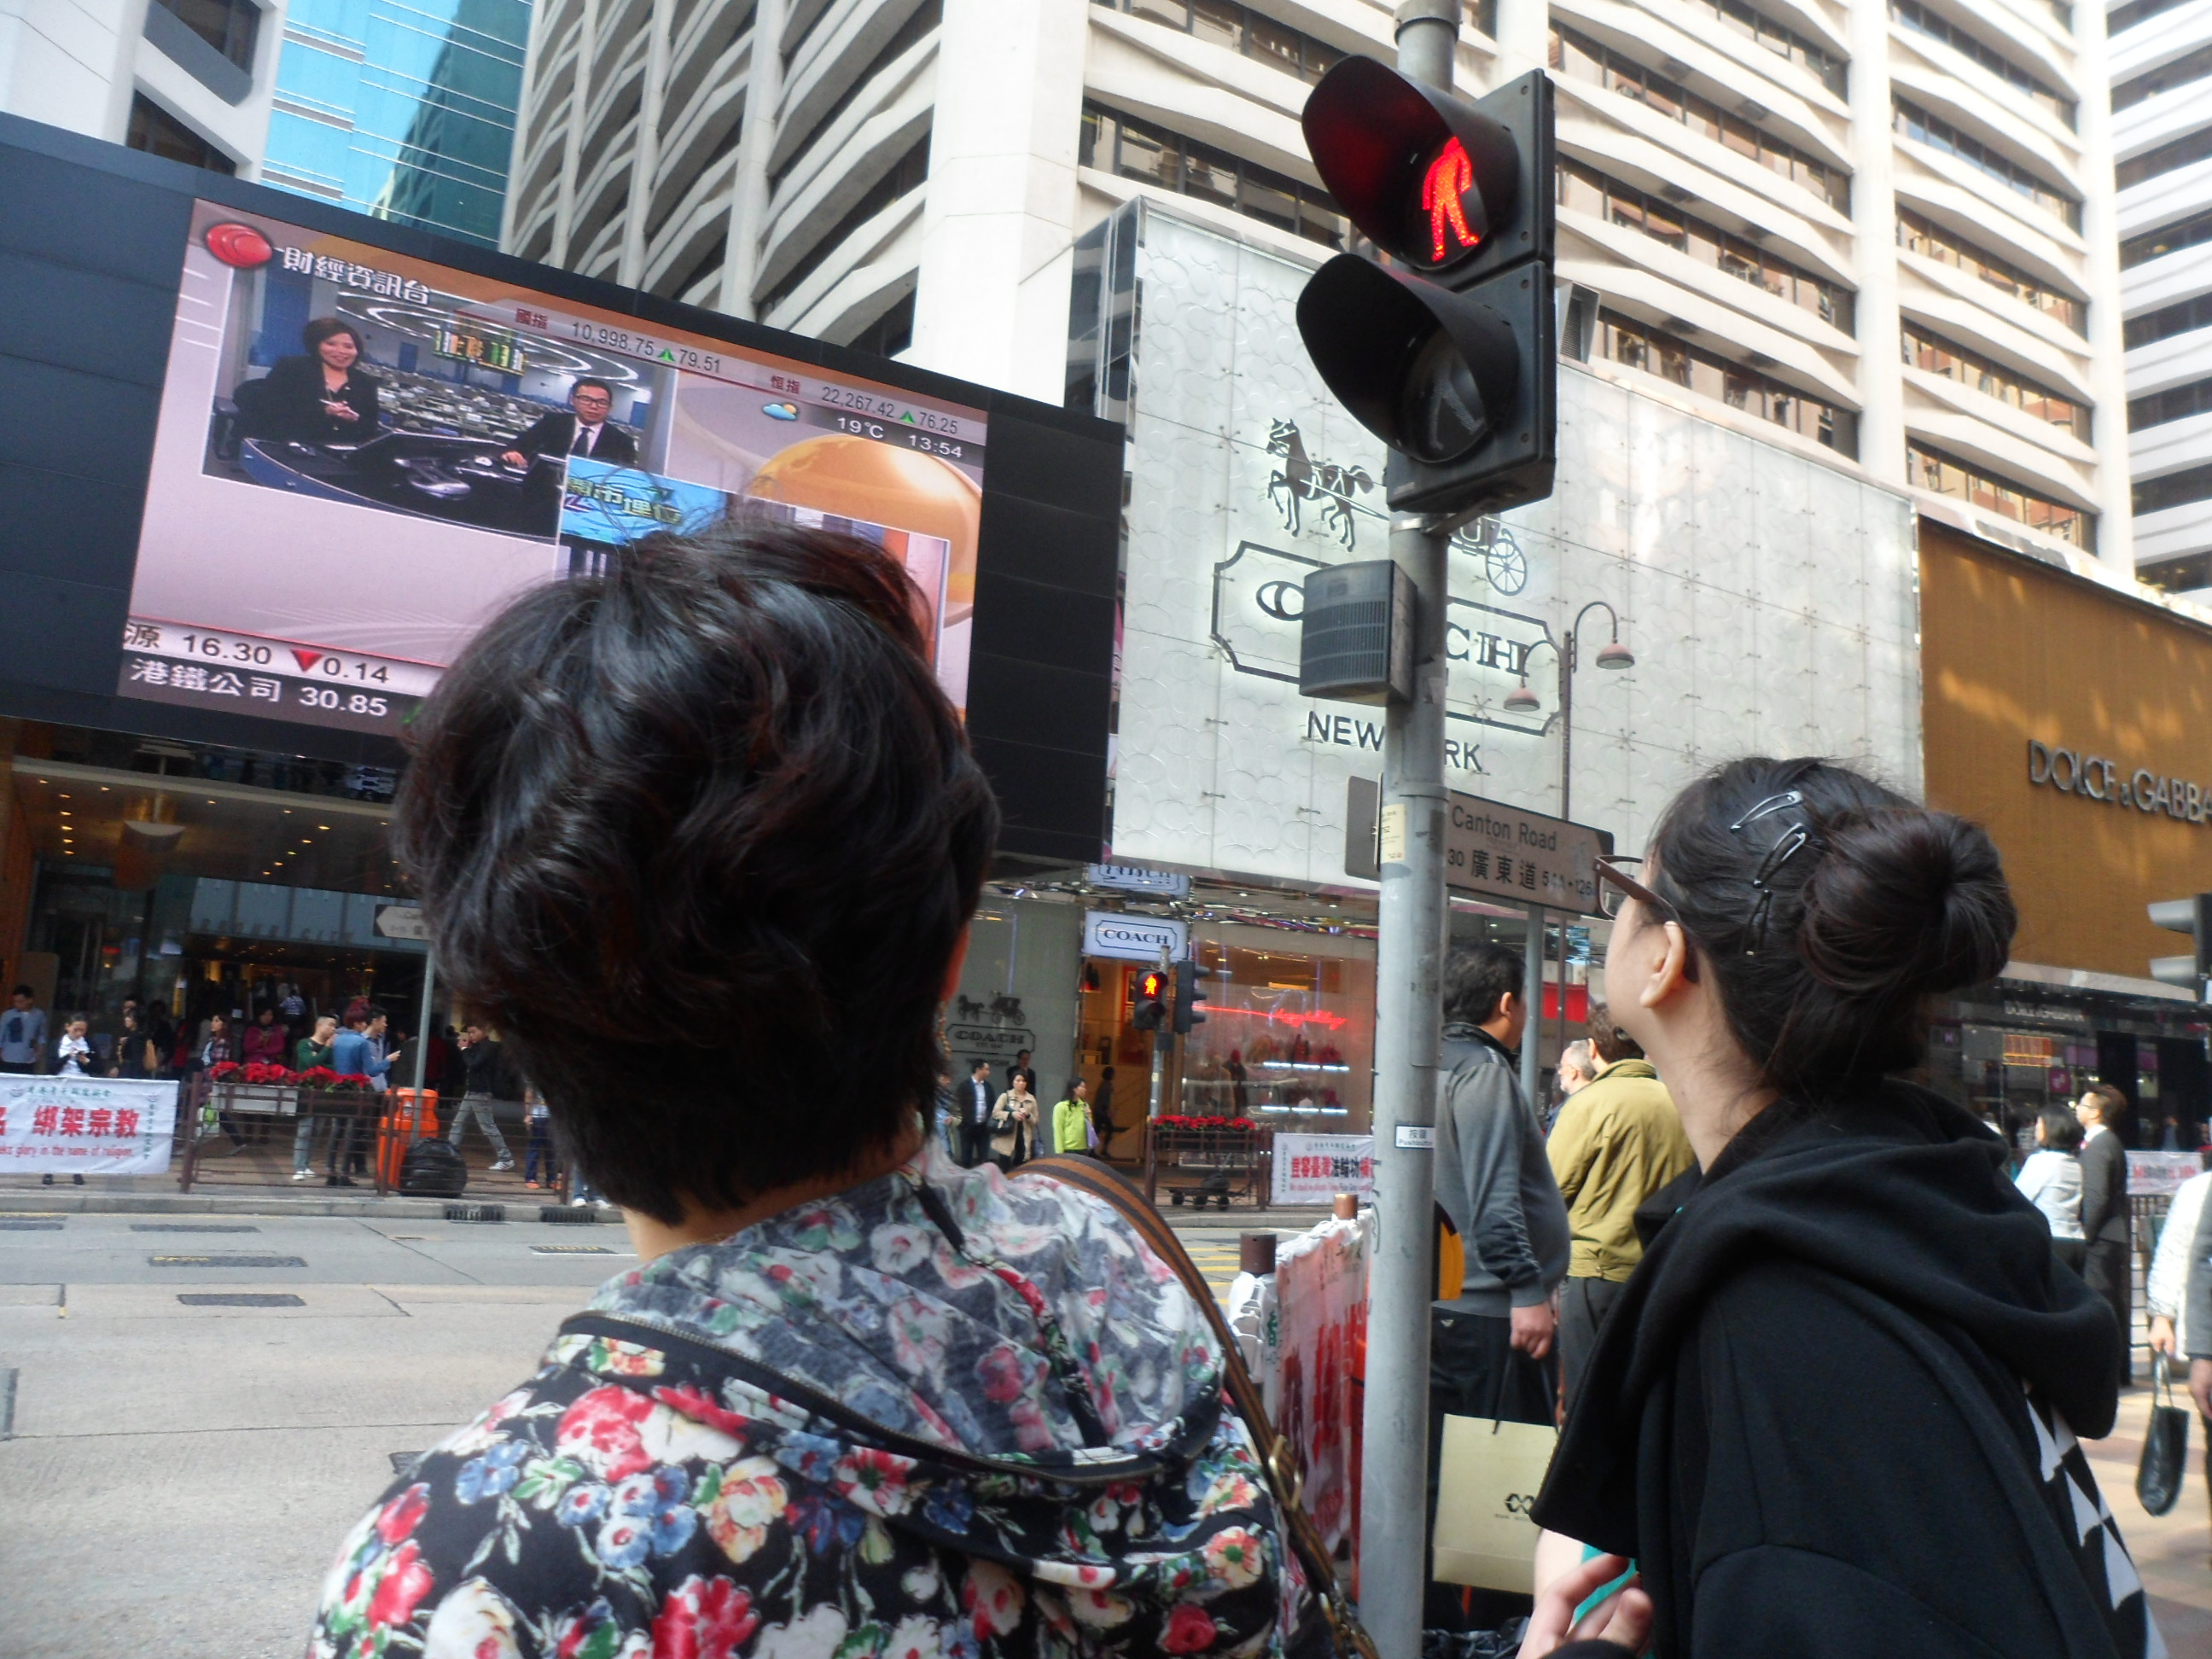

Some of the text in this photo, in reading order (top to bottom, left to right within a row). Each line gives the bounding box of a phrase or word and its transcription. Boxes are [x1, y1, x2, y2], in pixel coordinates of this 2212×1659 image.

[282, 246, 429, 306] 財經資訊台
[515, 308, 549, 330] 國指
[678, 348, 720, 372] 79.51
[919, 411, 958, 434] 76.25
[908, 434, 963, 459] 13:54
[1255, 580, 1531, 678] CCH
[183, 634, 271, 665] 16.30
[323, 656, 390, 684] 0.14
[131, 657, 388, 718] 港鐵公司 30.85
[1307, 710, 1387, 751] NEW
[2029, 739, 2116, 802] DOLCE
[1452, 805, 1557, 852] Canton Road
[1470, 849, 1536, 890] 廣東道
[1103, 928, 1168, 945] COACH
[955, 1030, 1025, 1044] COACH
